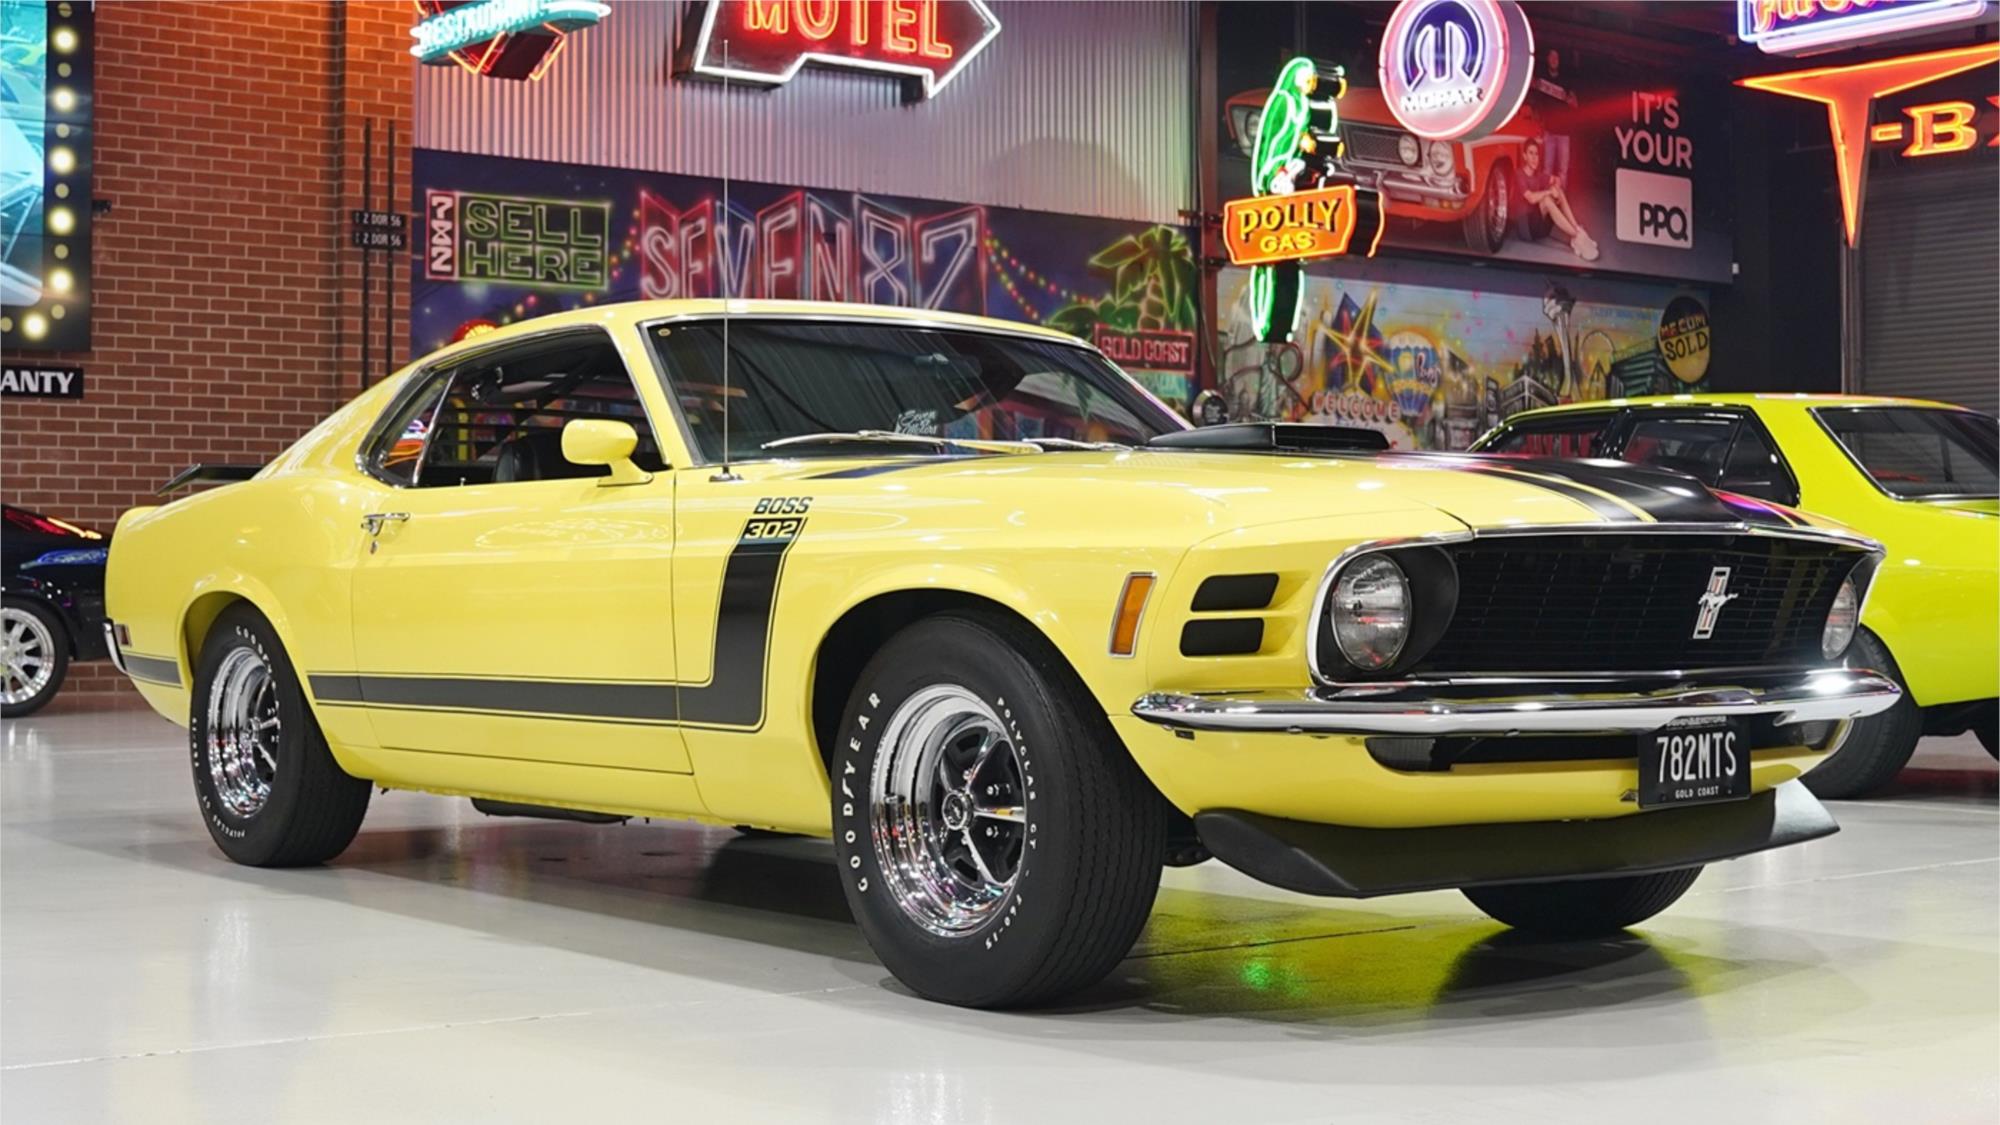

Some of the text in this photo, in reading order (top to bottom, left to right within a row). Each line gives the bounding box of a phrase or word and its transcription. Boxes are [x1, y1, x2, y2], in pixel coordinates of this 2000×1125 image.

[1401, 87, 1484, 113] MOPAR
[1632, 90, 1680, 130] IT'S
[1614, 125, 1693, 170] YOUR
[465, 199, 601, 248] SELL
[1237, 198, 1342, 244] POLLY
[1639, 201, 1689, 242] PPQ
[465, 240, 601, 284] HERE
[1260, 231, 1316, 253] GAS
[1101, 335, 1189, 363] GOLD COAST
[1664, 331, 1708, 361] SOLD
[0, 369, 75, 394] ANTY
[753, 496, 814, 515] BOSS
[743, 520, 799, 540] 302
[997, 697, 1037, 801] POLYGLAS
[1656, 731, 1737, 783] 782MTS
[841, 692, 882, 893] GOODYEAR
[1675, 785, 1719, 799] GOLD COAST
